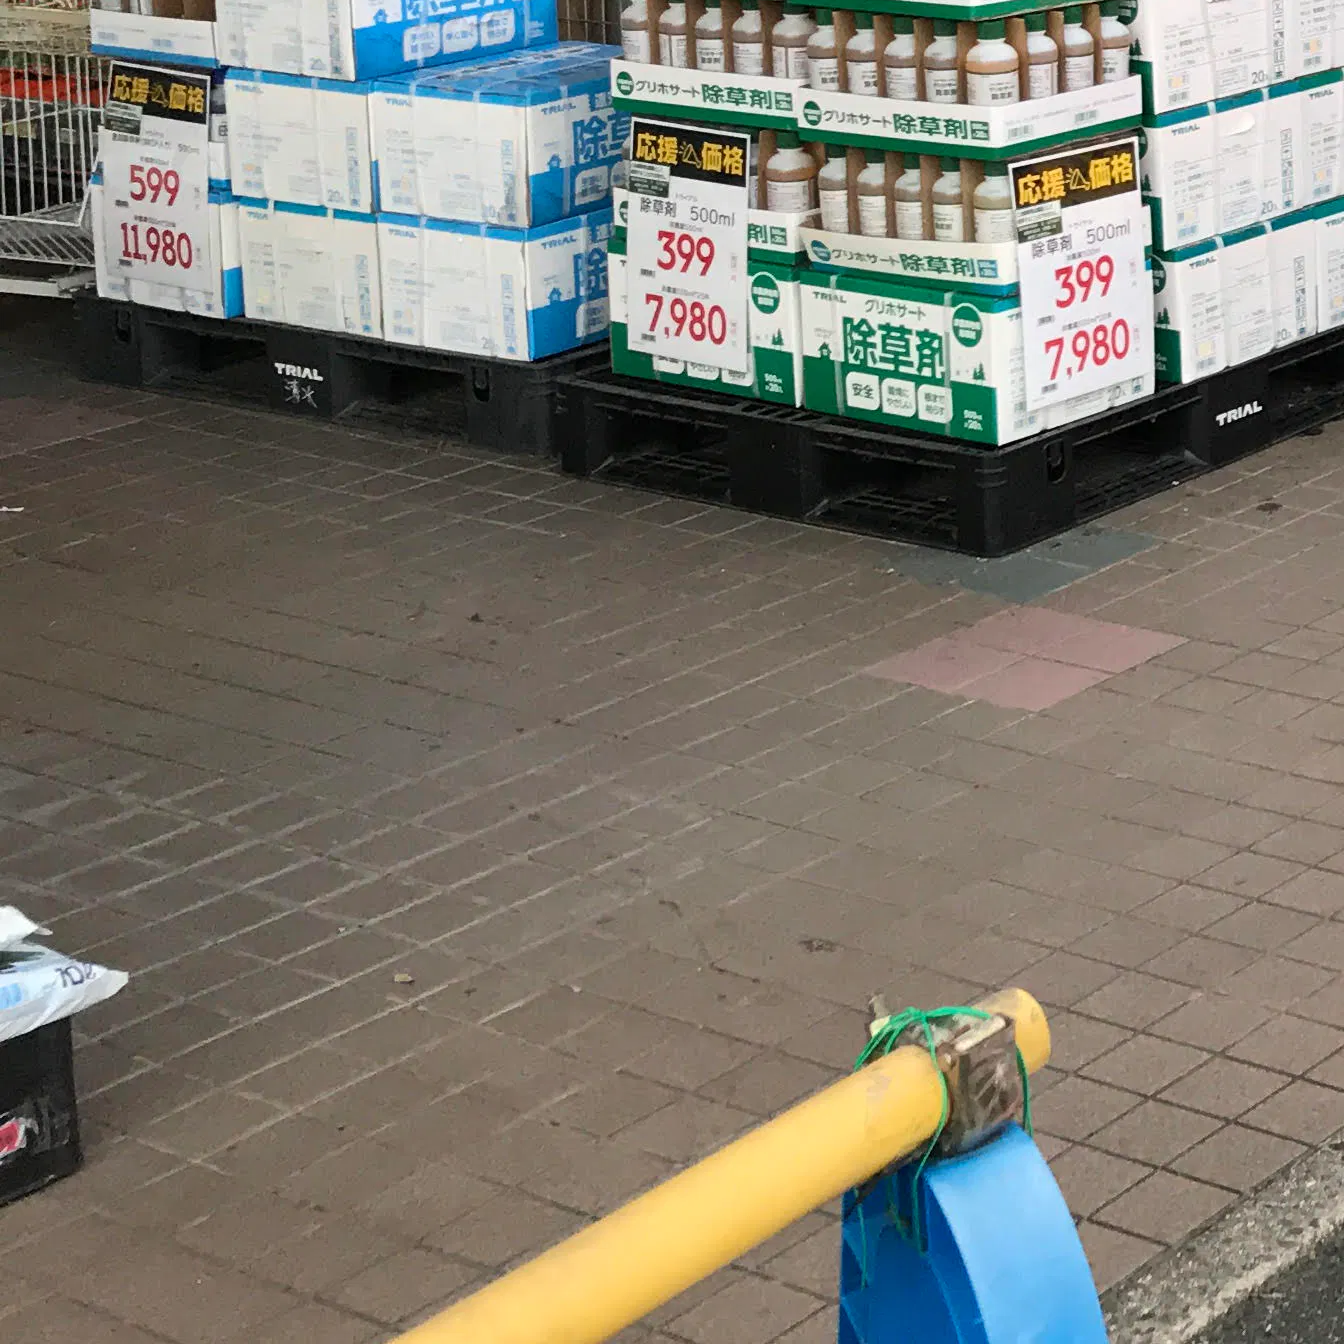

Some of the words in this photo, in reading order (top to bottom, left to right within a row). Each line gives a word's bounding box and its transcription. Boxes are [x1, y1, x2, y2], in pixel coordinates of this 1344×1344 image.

[113, 73, 150, 105] 応援
[169, 82, 205, 114] 価格
[540, 102, 577, 115] TRIAL
[635, 79, 774, 111] グリホサート除草剤
[1308, 88, 1335, 101] TRIAL
[821, 109, 970, 141] グリホサート除草剤
[1170, 123, 1201, 137] TRIAL
[635, 132, 679, 167] 応援
[701, 141, 744, 177] 価格
[129, 164, 181, 208] 599
[1017, 167, 1067, 206] 応援
[1088, 152, 1134, 191] 価格
[639, 197, 678, 219] 除草剤
[690, 206, 736, 228] 500ml
[120, 221, 193, 270] 11,980
[540, 234, 577, 251] TRIAL
[656, 230, 716, 278] 399
[1031, 234, 1073, 260] 除草剤
[1085, 219, 1132, 246] 500ml
[831, 248, 976, 278] グリホサート除草剤
[1188, 254, 1218, 270] TRIAL
[812, 290, 848, 304] TRIAL
[1054, 254, 1115, 309] 399
[644, 292, 728, 346] 7,980
[863, 299, 927, 322] グリホサート
[842, 316, 946, 380] 除草剤
[1044, 318, 1132, 381] 7,980
[274, 362, 324, 382] TRIAL
[1215, 400, 1263, 427] TRIAL
